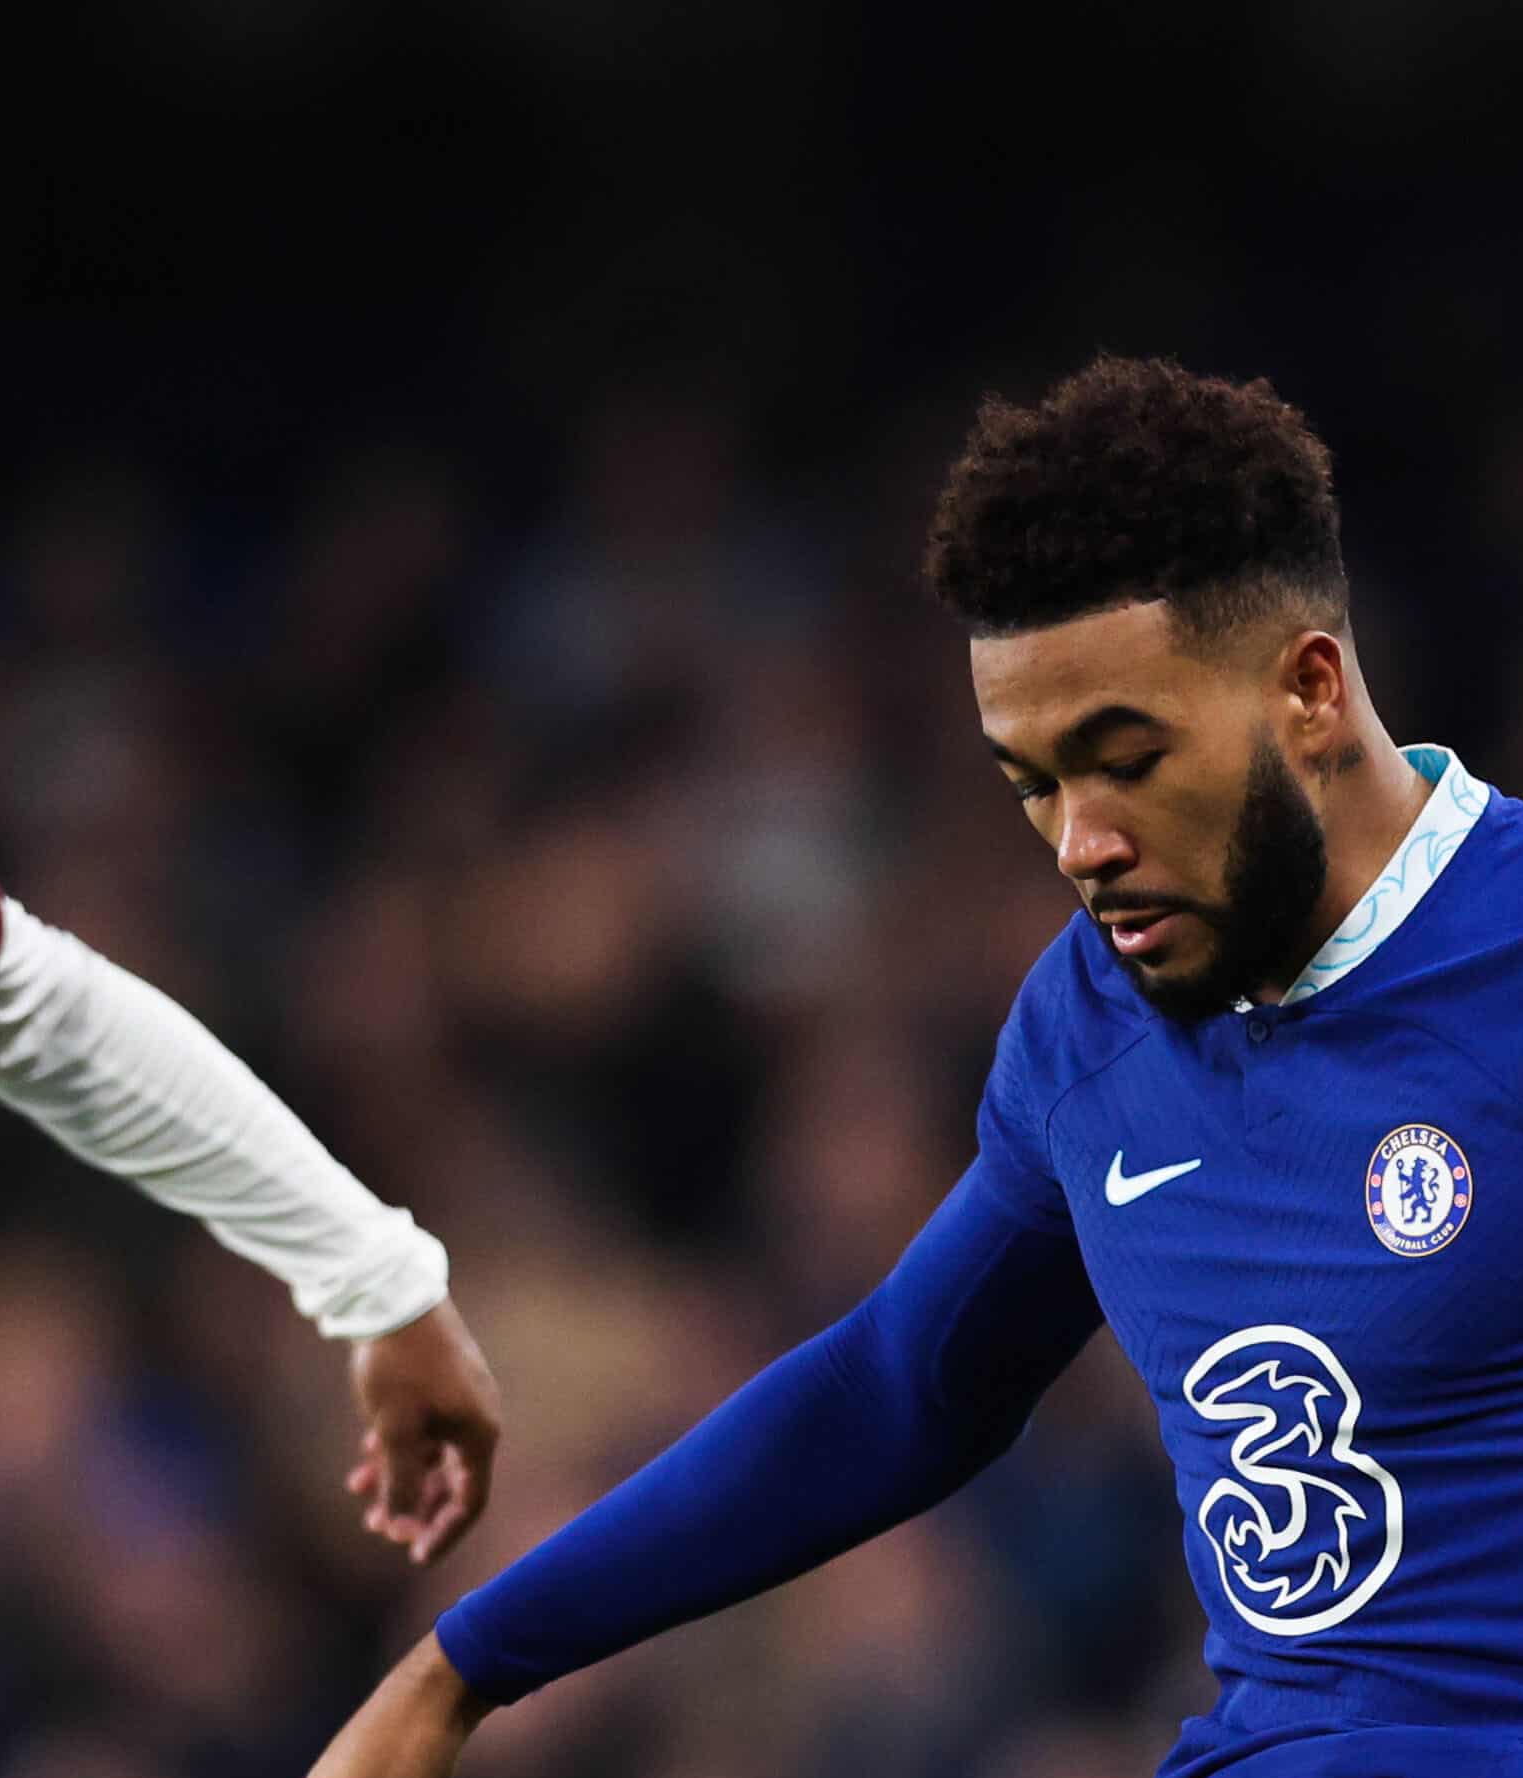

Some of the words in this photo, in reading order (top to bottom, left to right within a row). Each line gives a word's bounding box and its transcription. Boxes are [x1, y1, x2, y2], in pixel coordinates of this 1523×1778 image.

[1380, 1129, 1449, 1160] CHELSEA
[1430, 1222, 1455, 1245] CLUB
[1182, 1324, 1404, 1637] 3
